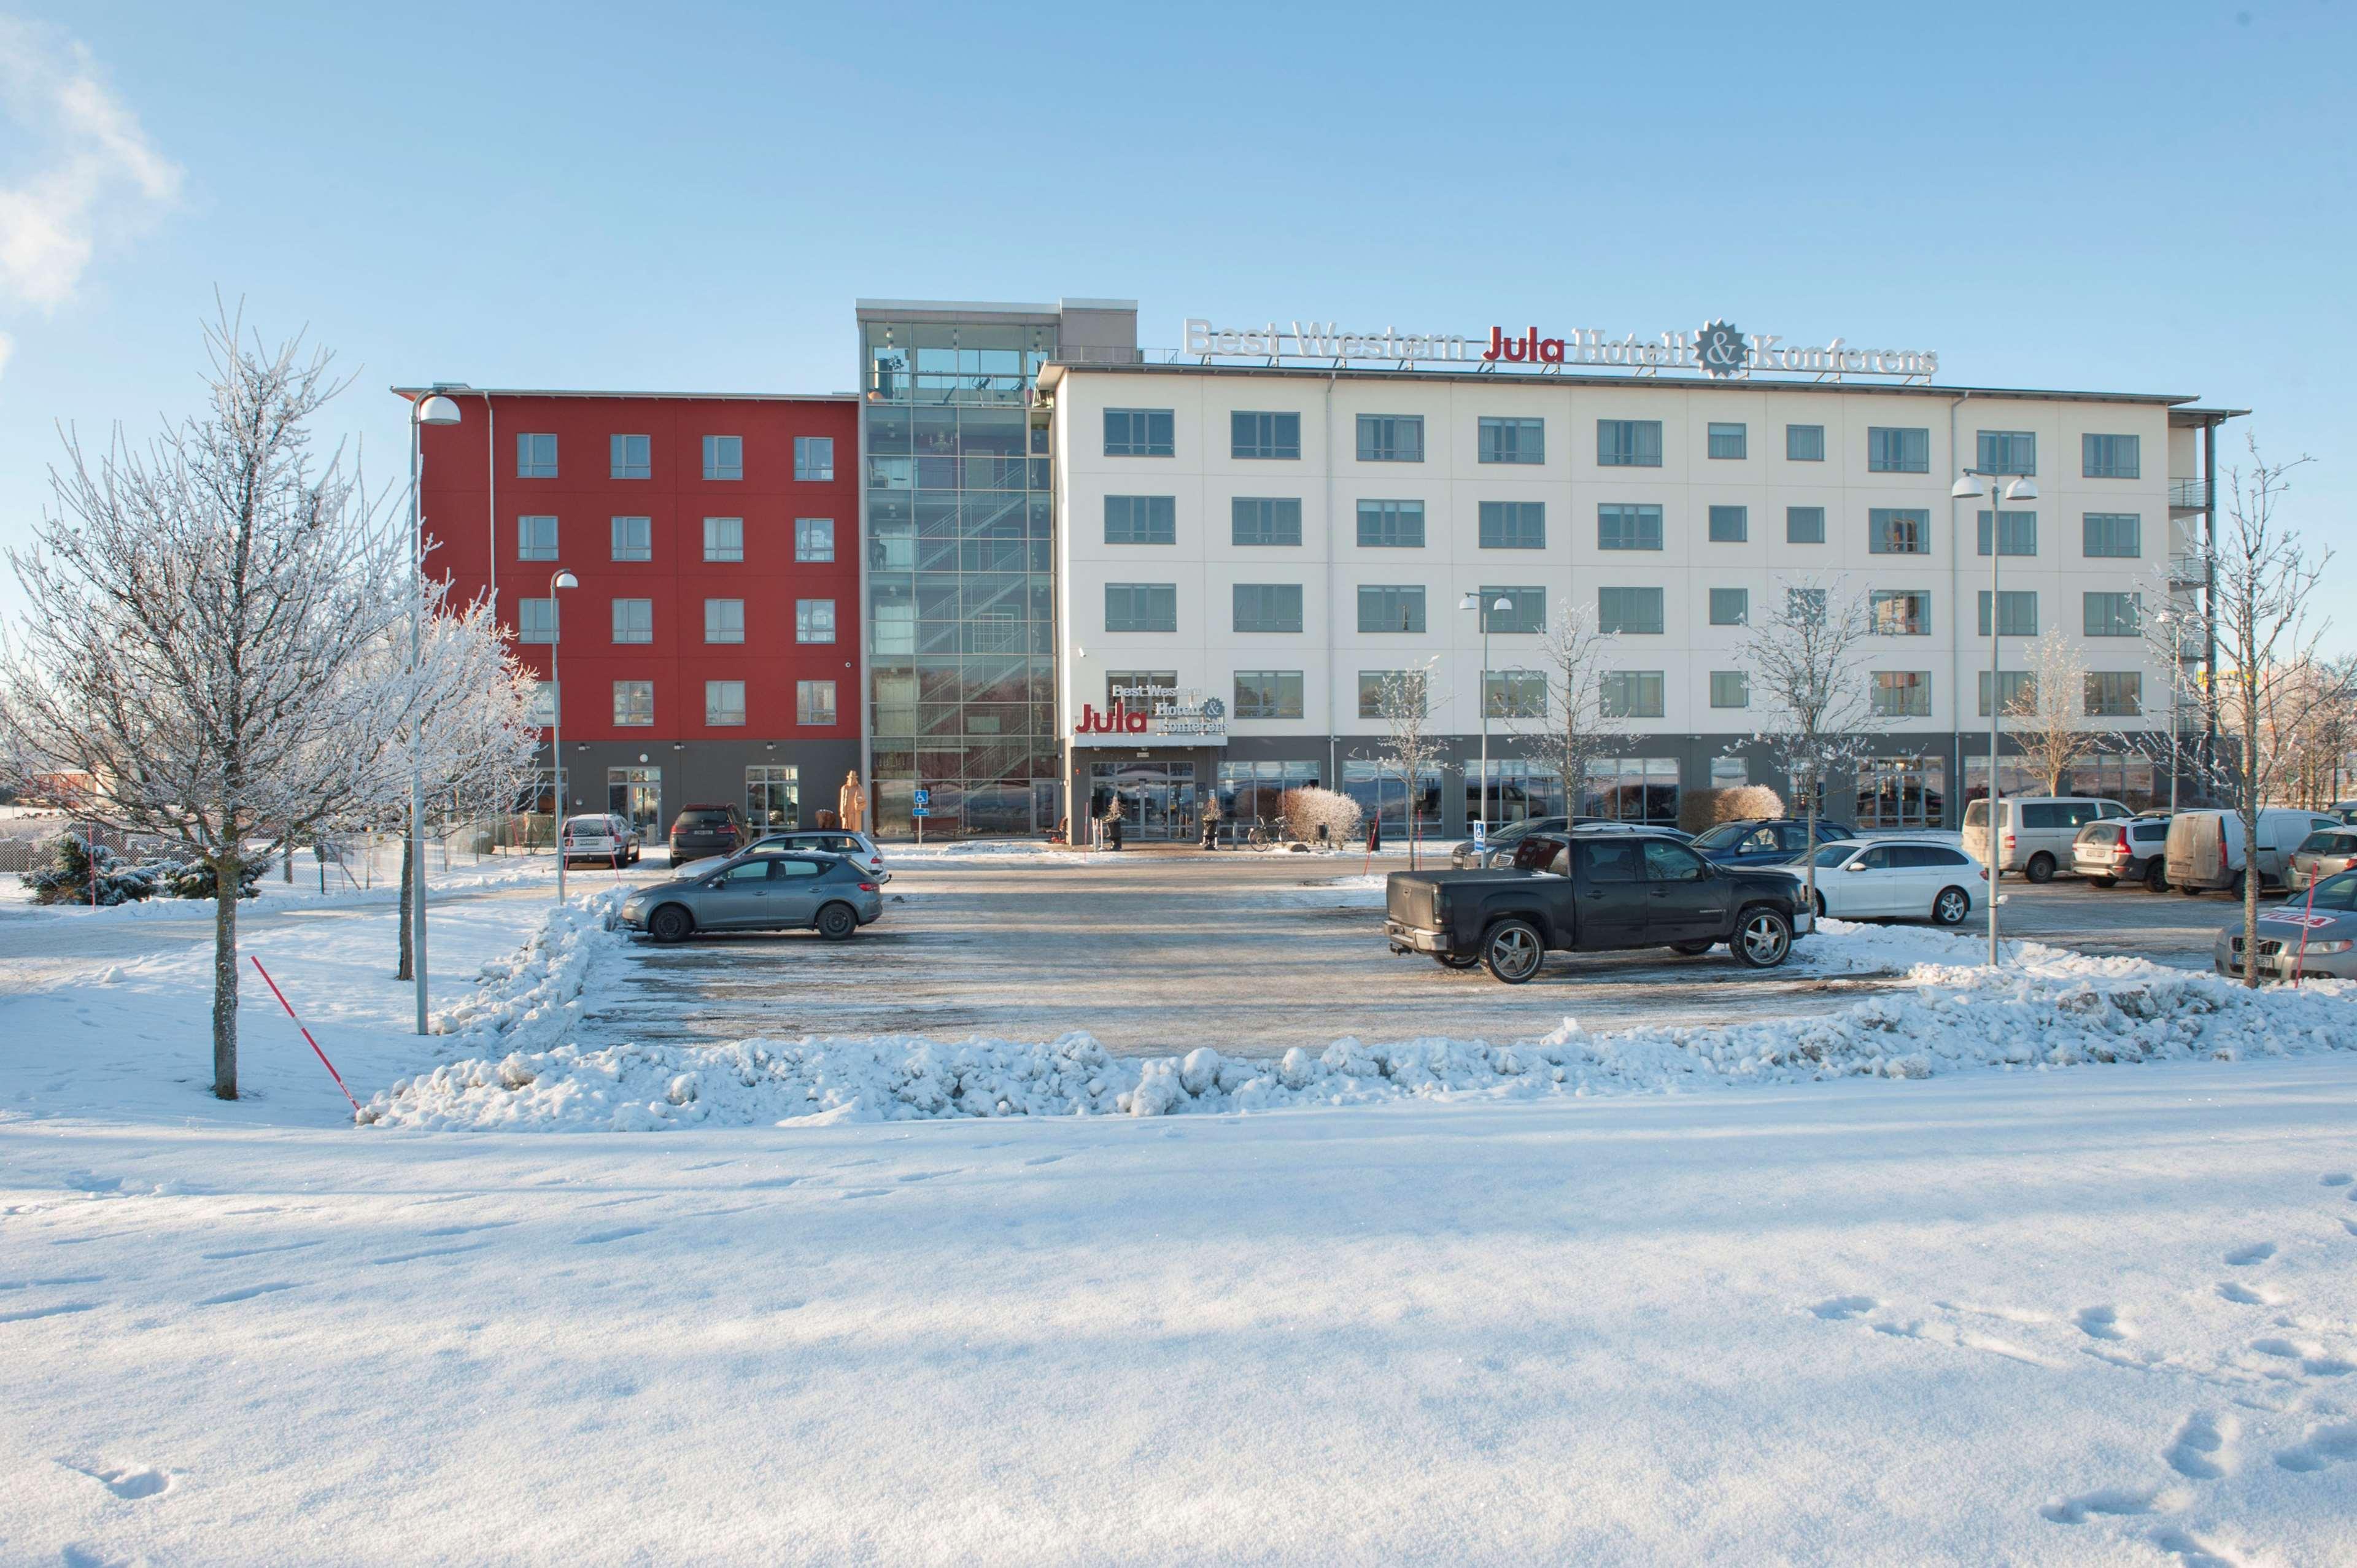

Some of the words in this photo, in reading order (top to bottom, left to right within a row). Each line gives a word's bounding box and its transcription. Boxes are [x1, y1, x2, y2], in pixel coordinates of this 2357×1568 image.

[1184, 318, 1280, 357] Best
[1293, 320, 1466, 361] Western
[1482, 325, 1565, 363] Jula
[1571, 328, 1690, 366] Hotell
[1706, 331, 1736, 365] &
[1751, 334, 1940, 375] Konferens
[1112, 684, 1142, 697] Best
[1075, 701, 1147, 733] Jula
[1207, 701, 1220, 715] &
